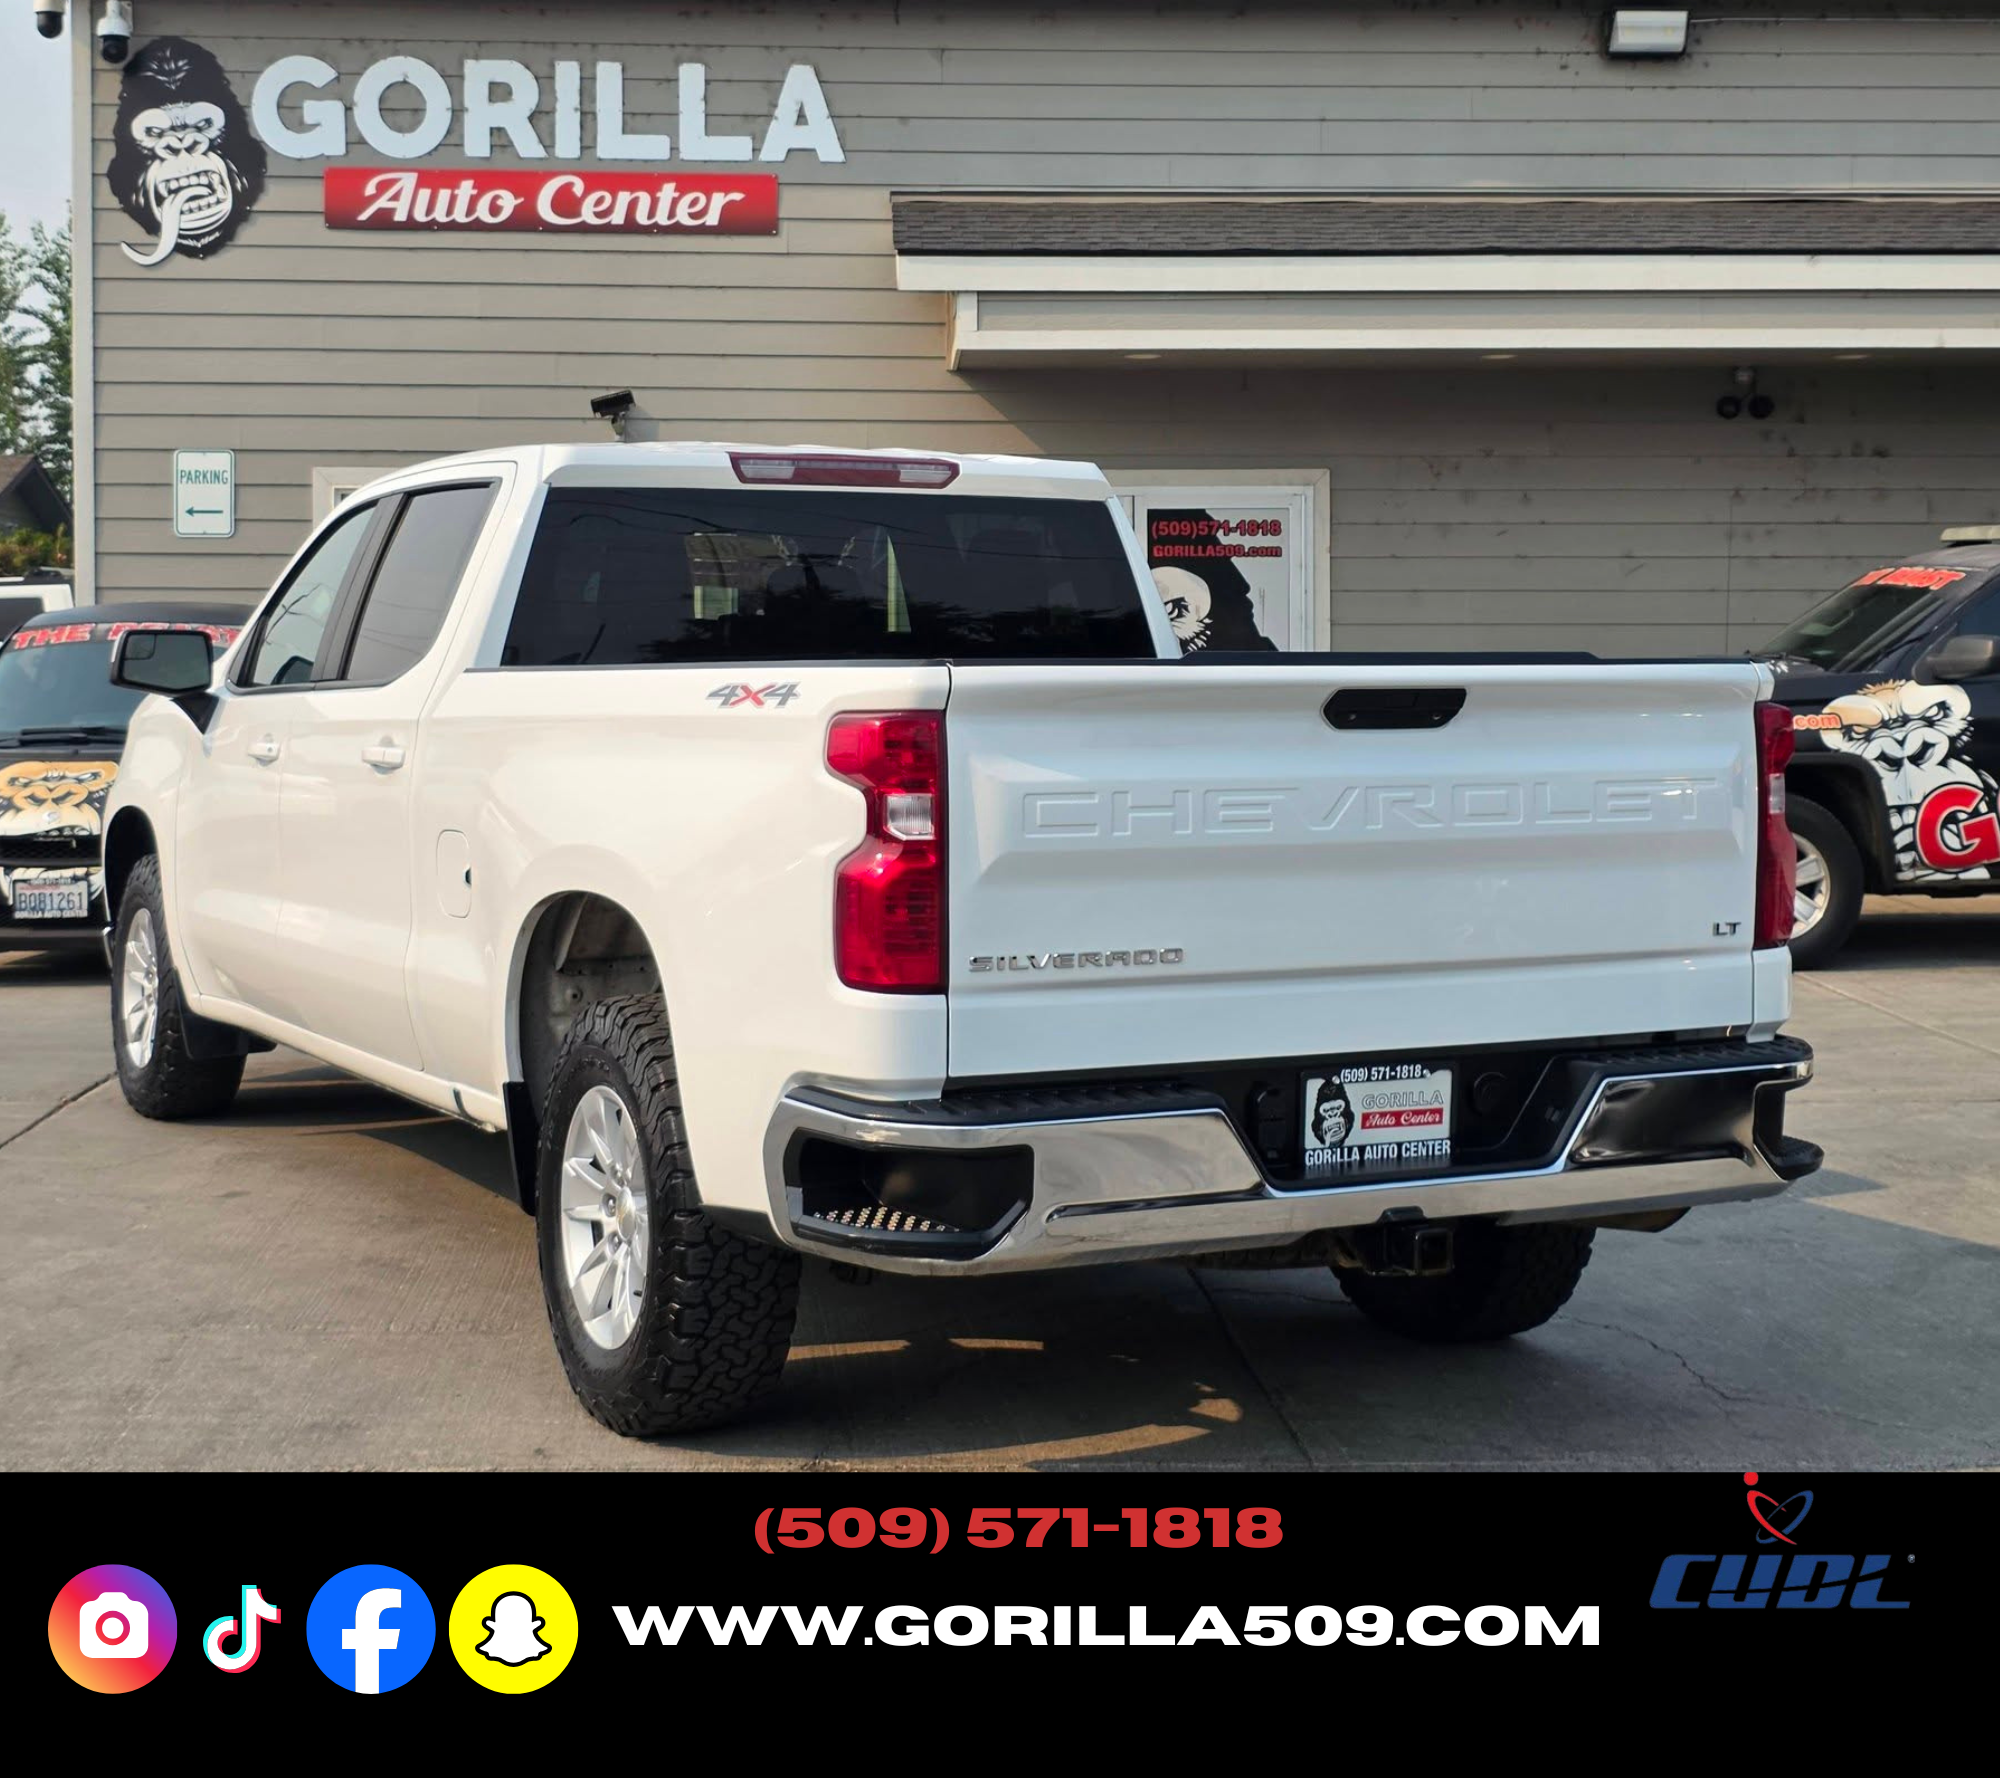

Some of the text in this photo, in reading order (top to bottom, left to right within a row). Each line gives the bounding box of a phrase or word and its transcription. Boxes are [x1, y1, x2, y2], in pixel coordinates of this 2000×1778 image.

[252, 55, 846, 162] GORILLA
[357, 172, 745, 226] Auto Center
[180, 469, 229, 485] PARKING
[1152, 519, 1283, 539] (509)571-1818
[1153, 544, 1283, 558] GORILLA509.com
[12, 623, 96, 649] THE
[1022, 775, 1720, 838] CHEVROLET
[1712, 921, 1742, 937] LT
[969, 948, 1184, 973] SILVERADO
[1340, 1064, 1422, 1083] (509) 571-1818
[1362, 1090, 1443, 1110] GORILLA
[1365, 1111, 1440, 1127] Auto Center
[1305, 1140, 1451, 1166] GORILLA AUTO CENTER
